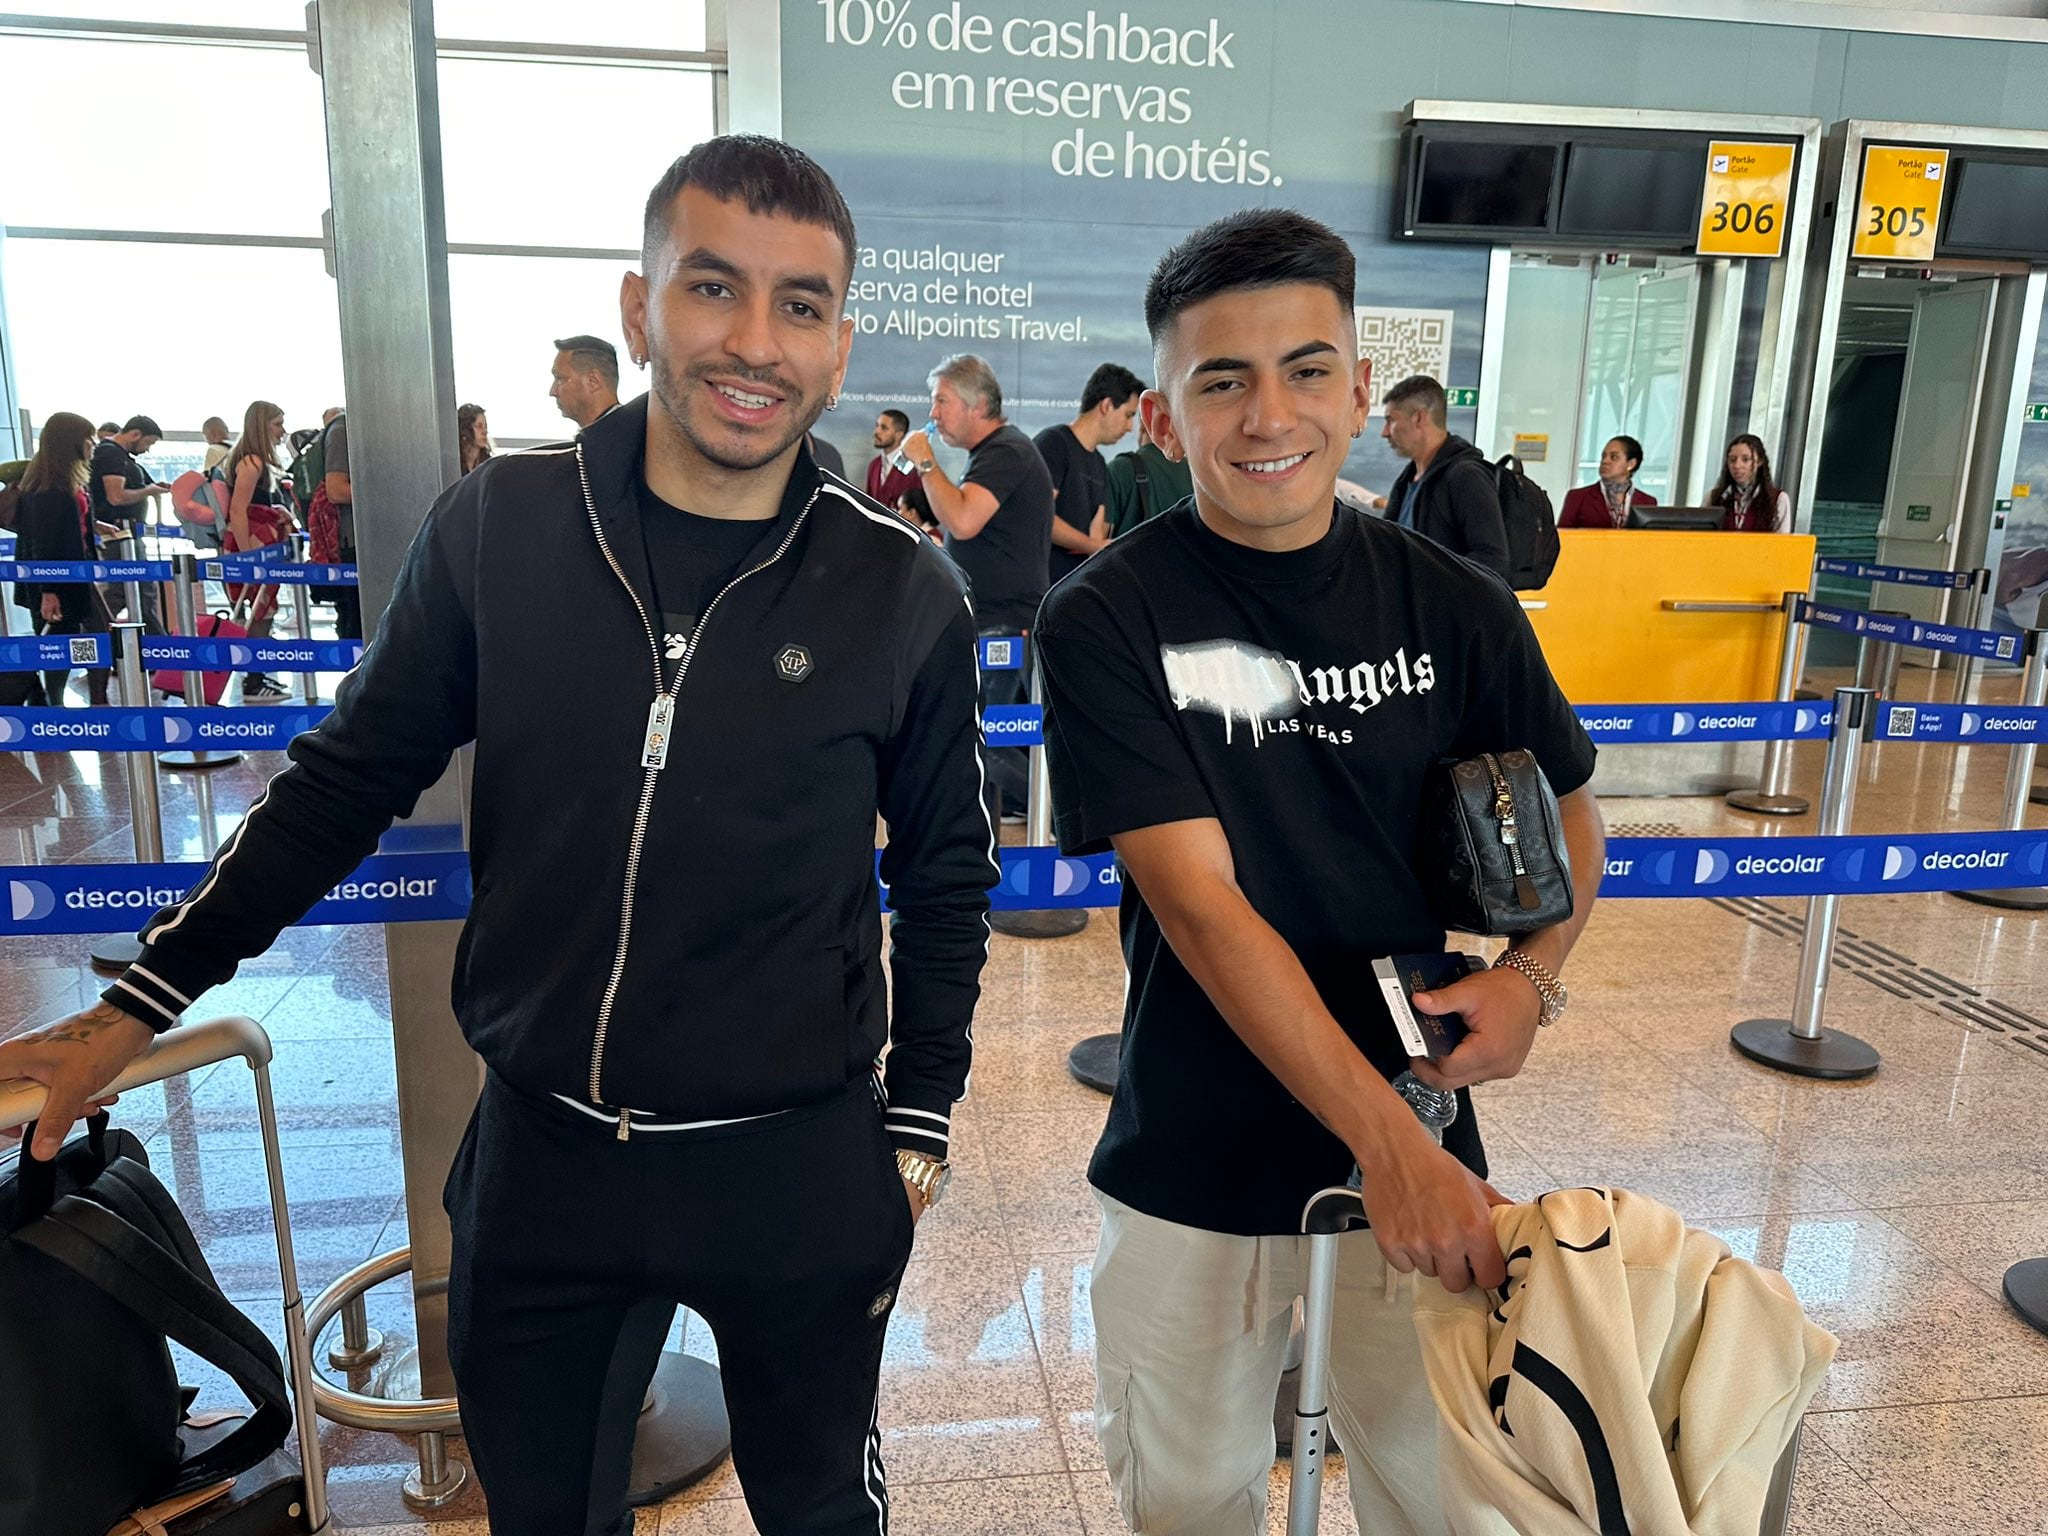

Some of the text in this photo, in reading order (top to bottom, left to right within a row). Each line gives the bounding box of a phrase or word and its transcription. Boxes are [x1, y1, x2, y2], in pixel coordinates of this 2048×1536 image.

[817, 0, 1235, 68] 10% de cashback
[891, 70, 1192, 124] em reservas
[1051, 128, 1284, 187] de hotéis.
[1731, 155, 1756, 165] Portão
[1898, 159, 1923, 169] Portão
[1731, 165, 1749, 174] Gate
[1903, 169, 1922, 179] Gate
[1711, 201, 1774, 235] 306
[1867, 205, 1927, 237] 305
[882, 244, 1004, 276] qualquer
[846, 278, 1033, 308] serva de hotel
[883, 308, 1001, 341] Allpoints
[1005, 315, 1088, 343] Travel.
[33, 566, 146, 576] decolar decolar
[269, 569, 305, 579] decolar
[1868, 619, 1896, 633] decolar
[1925, 630, 1957, 643] decolar
[141, 647, 314, 661] ecolar decolar
[31, 720, 275, 737] decolar decolar
[1266, 719, 1300, 734] LAS
[1698, 714, 1757, 729] decolar
[1984, 715, 2037, 731] decolar
[1735, 850, 2009, 875] decolar decolar
[65, 885, 185, 909] decolar
